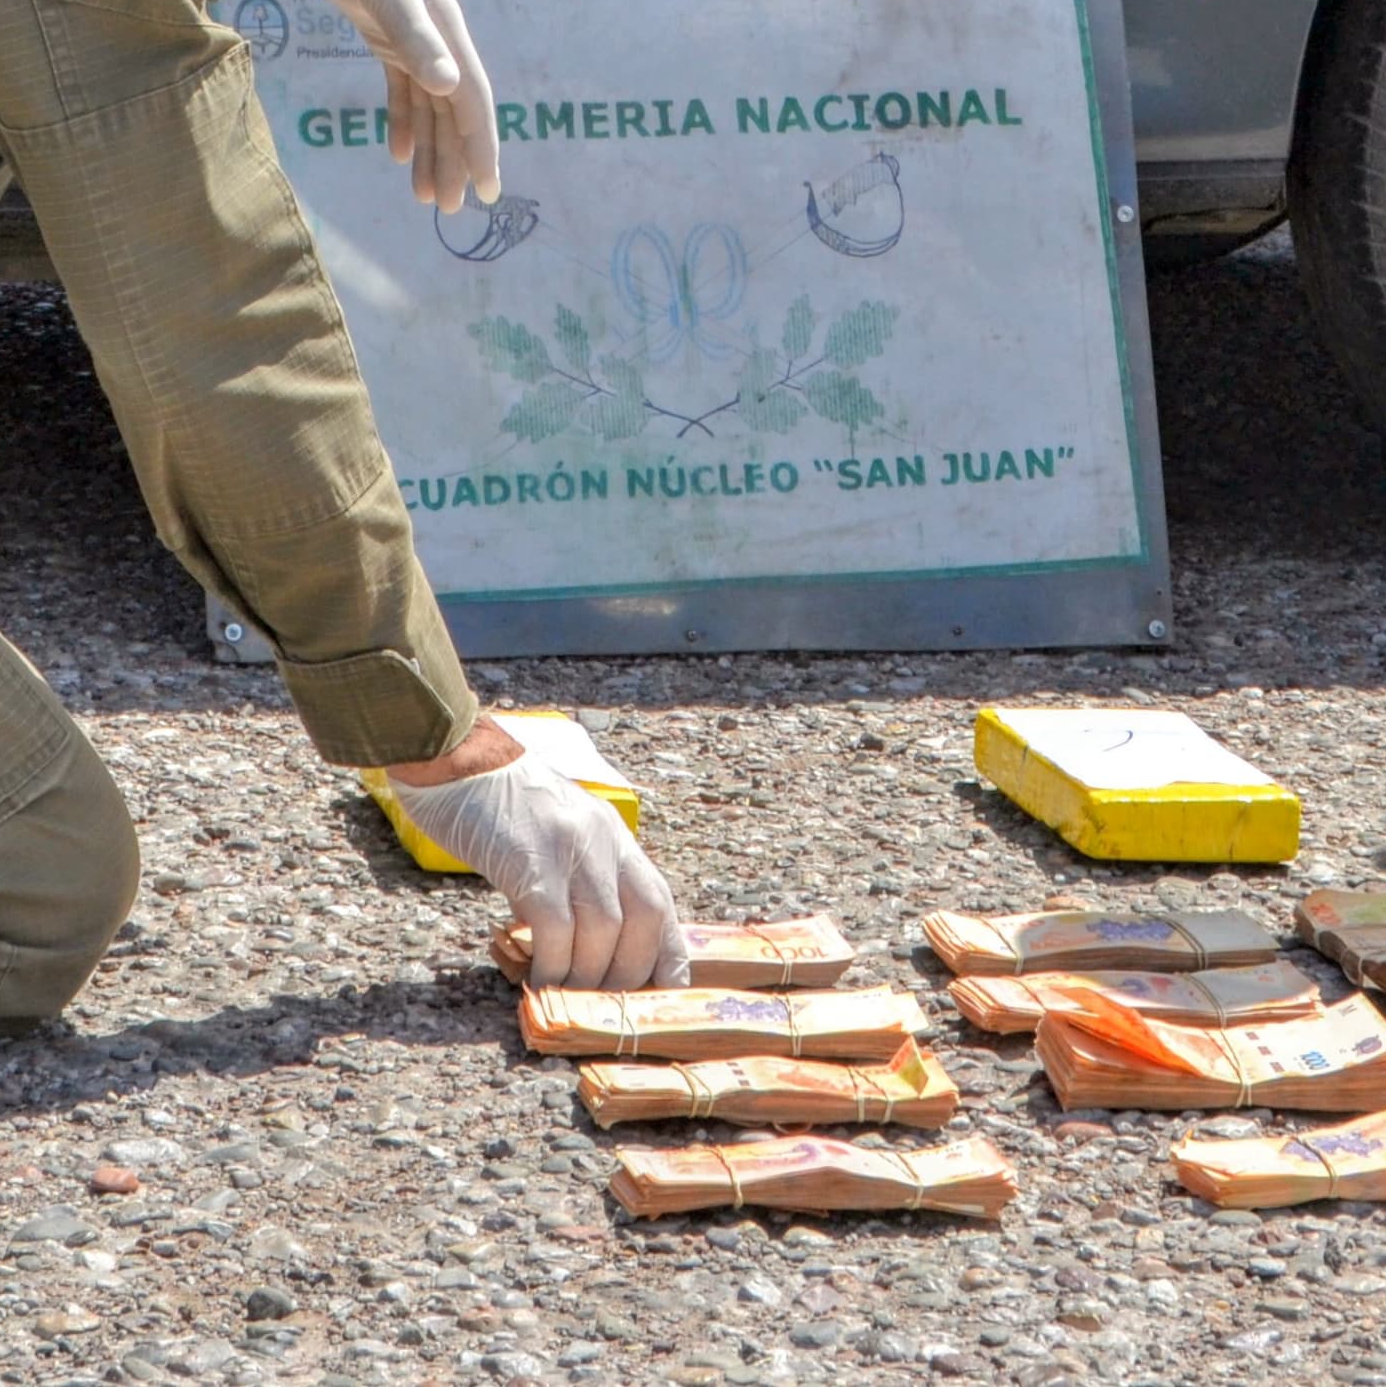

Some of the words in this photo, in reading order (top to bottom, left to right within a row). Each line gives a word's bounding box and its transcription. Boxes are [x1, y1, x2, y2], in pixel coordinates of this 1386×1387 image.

[297, 98, 716, 147] GERMERIA
[735, 88, 1023, 134] NACIONAL
[626, 456, 800, 499] NÚCLEO
